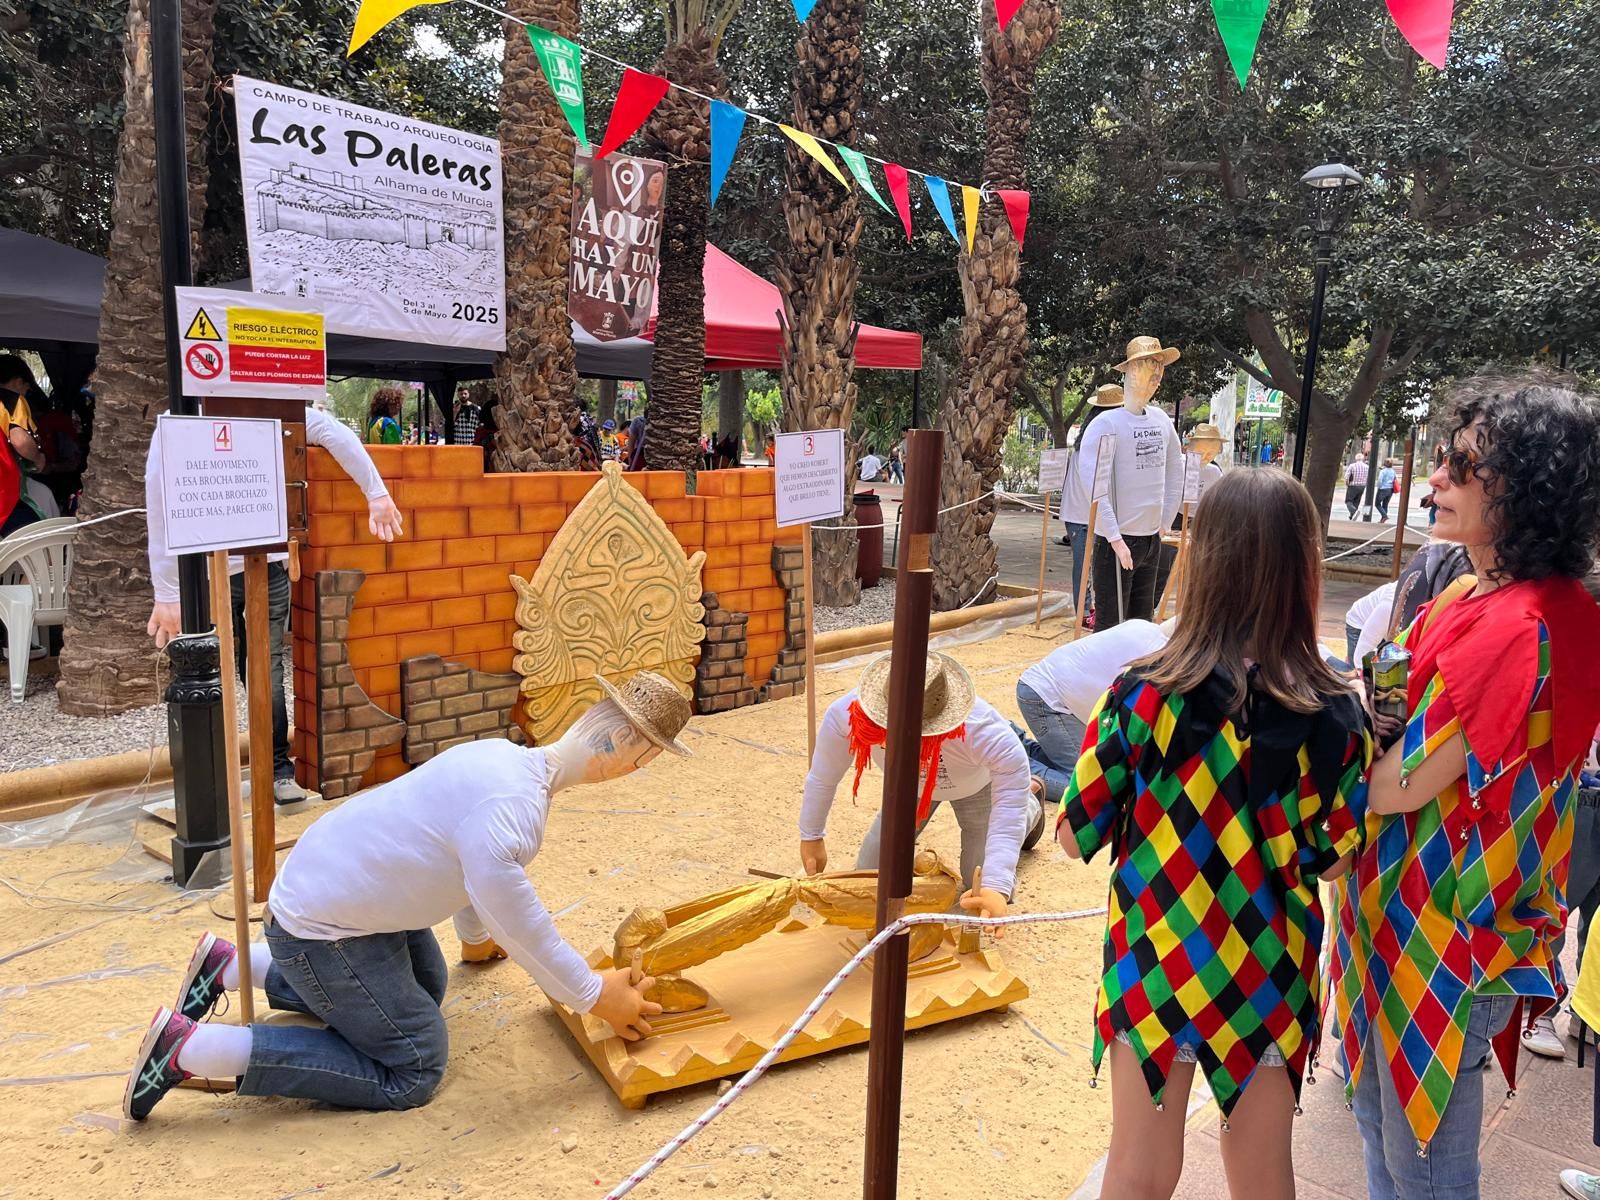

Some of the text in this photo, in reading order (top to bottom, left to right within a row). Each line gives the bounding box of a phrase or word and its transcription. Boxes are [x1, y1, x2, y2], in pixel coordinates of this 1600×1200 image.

[253, 88, 494, 154] CAMPO DE TRABAJO ARQUEOLOGÍA
[249, 107, 492, 191] Las Paleras
[374, 176, 493, 208] Alhama de Murcia
[577, 197, 660, 248] AQUÍ
[573, 236, 656, 275] HAY UN
[572, 261, 652, 308] MAYO
[403, 298, 418, 307] Del
[403, 306, 409, 314] 5
[424, 310, 448, 319] Mayo
[452, 302, 499, 324] 2025
[233, 323, 318, 336] RIESGO ELÉCTRICO
[276, 337, 317, 345] INTERRUPTOR
[216, 424, 230, 448] 4
[804, 436, 813, 453] 3
[186, 460, 259, 470] DALE MOVIMENTO
[174, 474, 270, 486] A ESA BROCHA BRIGITTE,
[180, 488, 268, 502] CON CADA BROCHAZO
[171, 507, 205, 519] RELUCE
[206, 506, 225, 516] MAS,
[226, 504, 254, 516] PARECE
